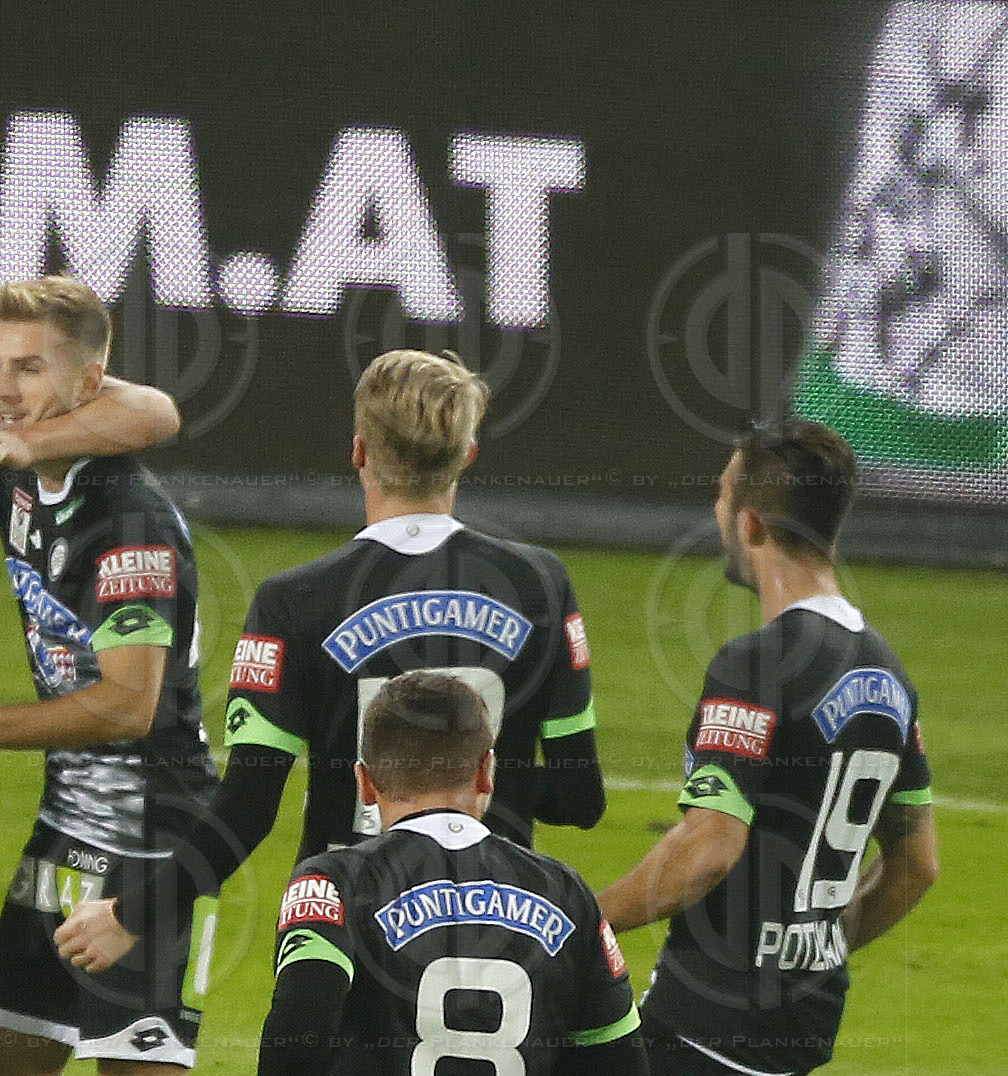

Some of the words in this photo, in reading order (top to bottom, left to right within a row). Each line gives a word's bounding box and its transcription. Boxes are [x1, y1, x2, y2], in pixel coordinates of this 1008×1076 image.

[98, 550, 172, 577] KLEINE
[98, 574, 173, 597] ZEITUNG
[334, 598, 522, 661] PUNTIGAMER
[793, 750, 900, 912] 19
[386, 890, 565, 946] PUNTIGAMER
